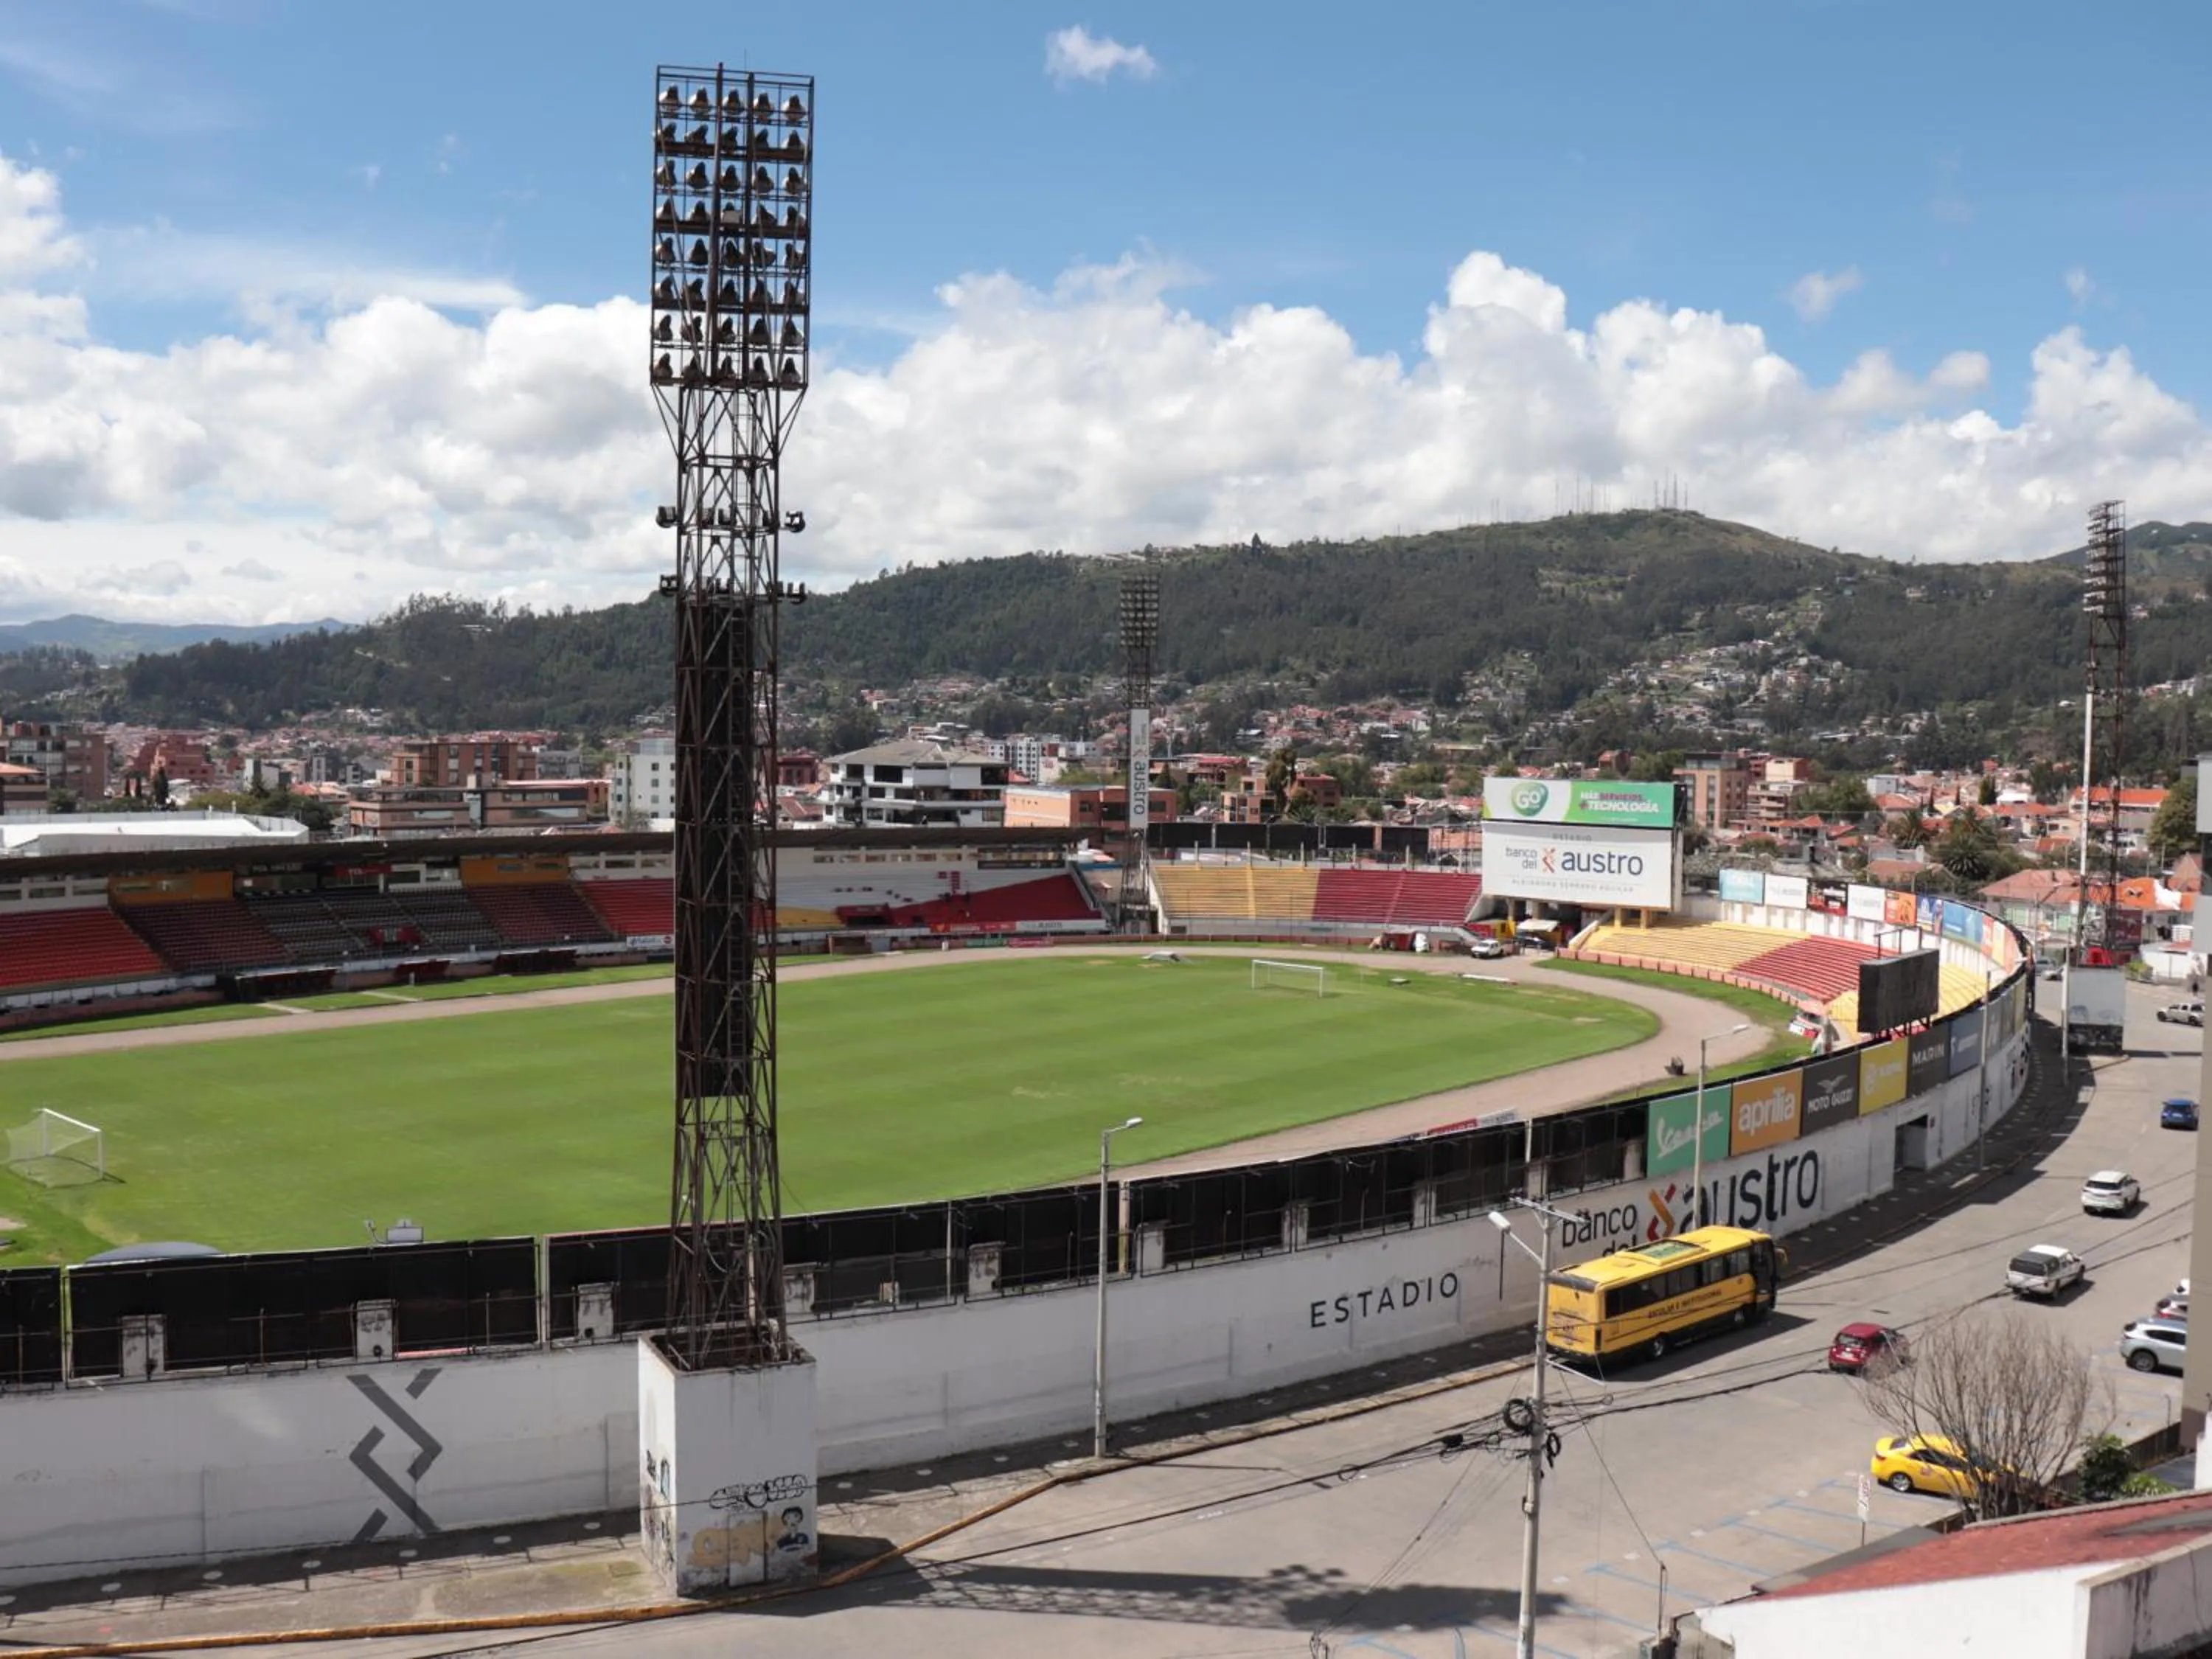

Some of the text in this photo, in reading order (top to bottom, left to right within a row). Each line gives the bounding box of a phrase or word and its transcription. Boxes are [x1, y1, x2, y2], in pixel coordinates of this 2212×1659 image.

[1133, 762, 1147, 815] austro
[1506, 847, 1537, 858] banco
[1522, 859, 1537, 870] del
[1561, 850, 1644, 876] austro
[1738, 1086, 1796, 1137] aprilia
[1807, 1095, 1830, 1113] MOTO
[1679, 1150, 1819, 1234] austro
[1562, 1204, 1638, 1248] banco
[1310, 1273, 1458, 1328] ESTADIO
